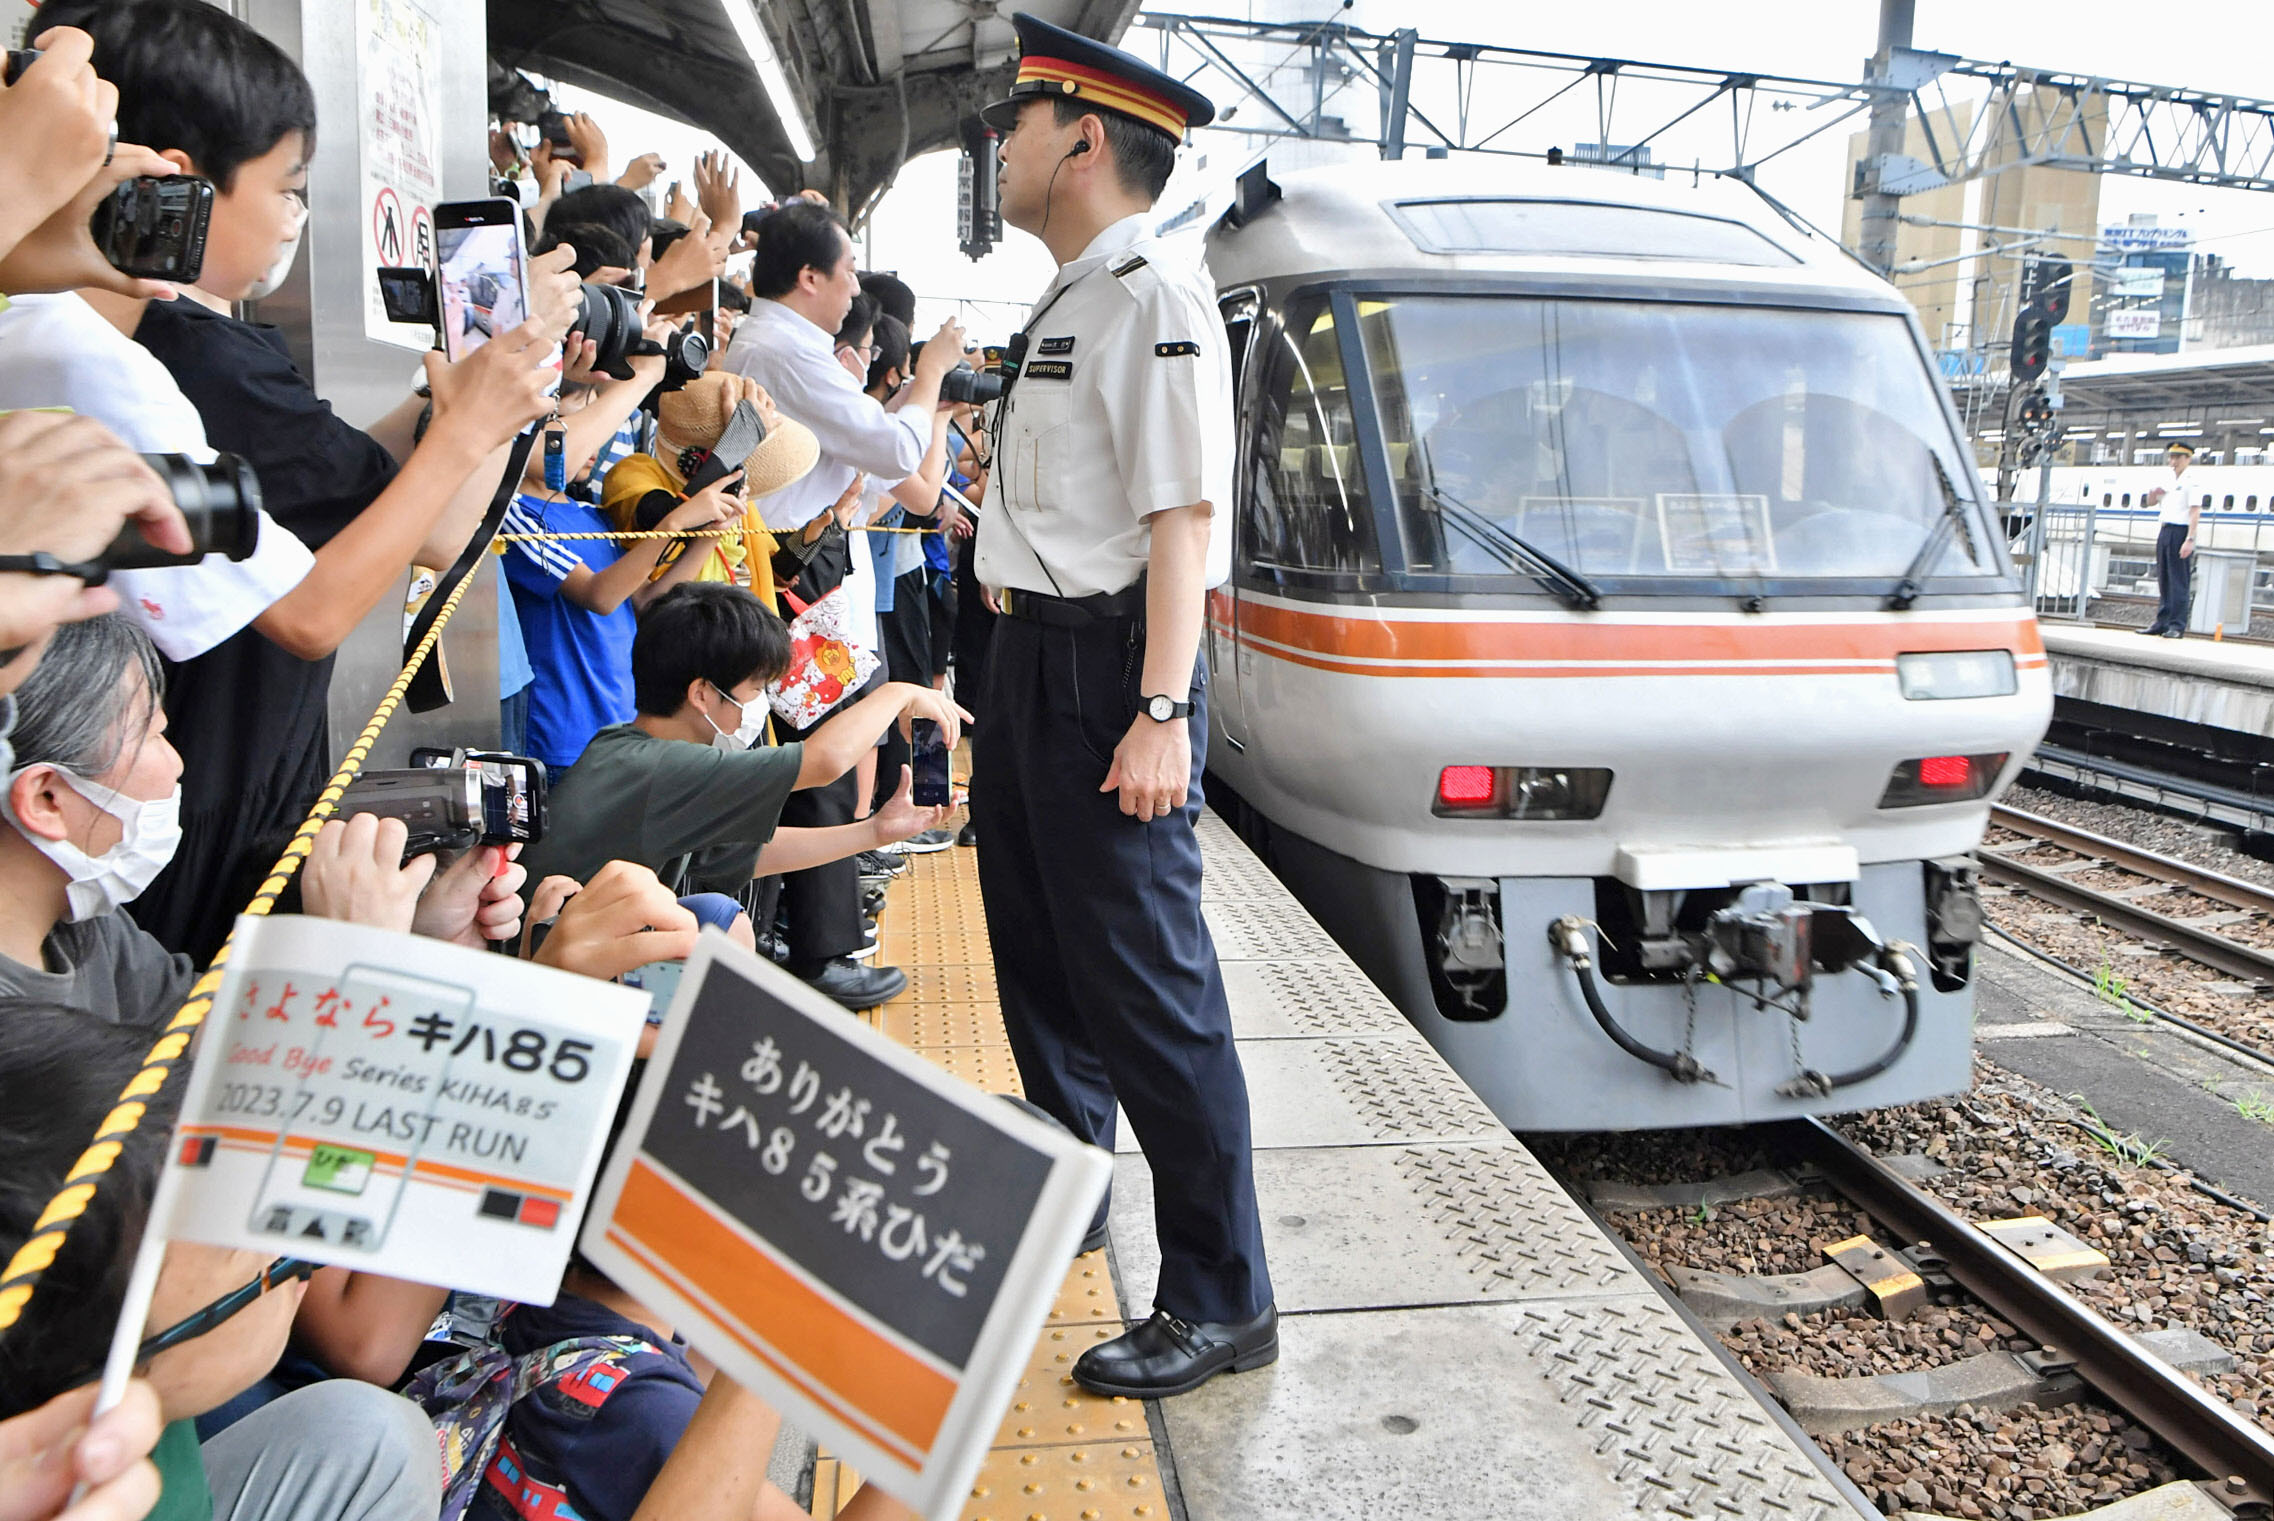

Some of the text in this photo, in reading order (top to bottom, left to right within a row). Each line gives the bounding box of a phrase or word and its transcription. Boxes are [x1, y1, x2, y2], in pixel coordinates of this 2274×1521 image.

[1028, 363, 1067, 376] SUPERVISOR
[216, 1082, 529, 1163] 2023.7.9 LAST RUN
[283, 1046, 334, 1079] Bye
[341, 1056, 427, 1094] Series
[436, 1078, 558, 1121] KIHA85
[741, 1036, 951, 1196] ありがとう
[685, 1072, 986, 1298] キハ85系ひだ
